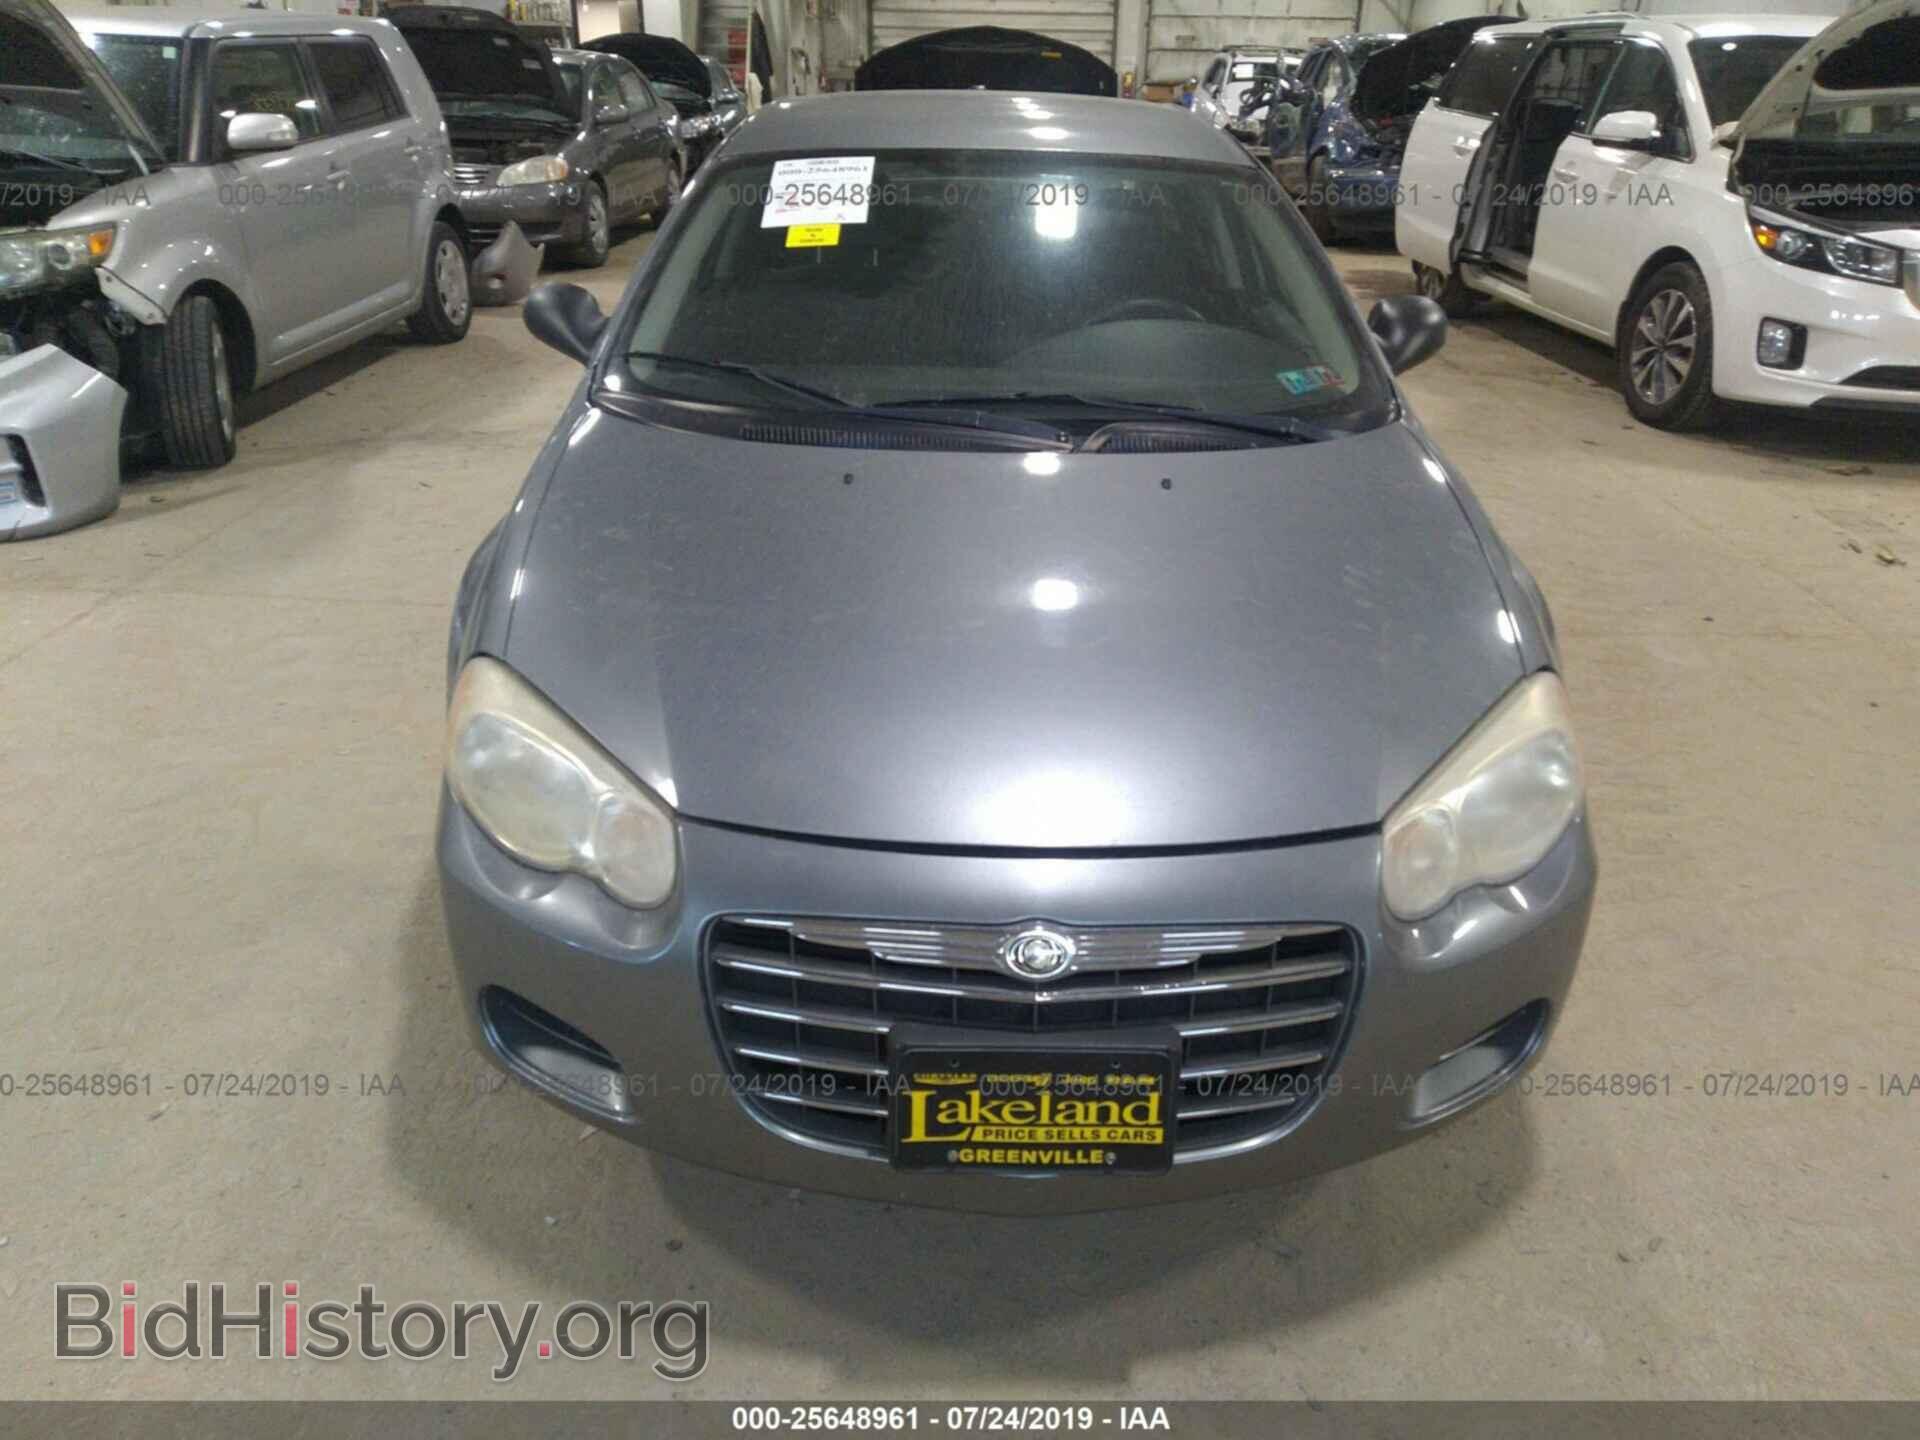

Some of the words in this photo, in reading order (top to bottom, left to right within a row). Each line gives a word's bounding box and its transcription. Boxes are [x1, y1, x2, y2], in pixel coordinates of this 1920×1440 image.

[902, 1089, 1163, 1142] Lakeland
[982, 1129, 1037, 1141] PRICE
[1044, 1129, 1101, 1141] SELLS
[1107, 1129, 1157, 1142] CARS
[959, 1148, 1104, 1165] GREENVILLE
